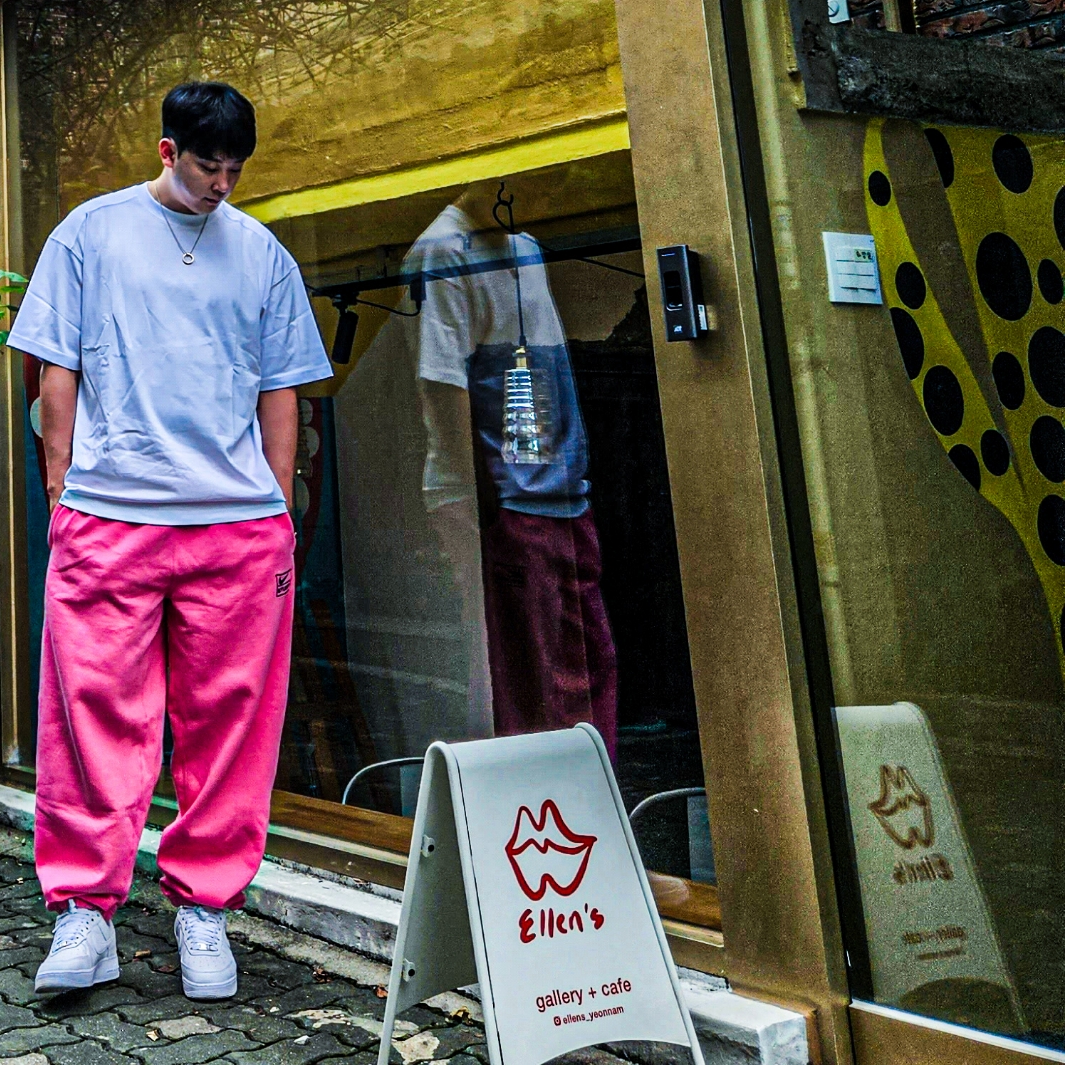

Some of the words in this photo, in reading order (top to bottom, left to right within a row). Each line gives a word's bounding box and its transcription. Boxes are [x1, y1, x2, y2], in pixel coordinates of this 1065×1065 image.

[519, 903, 605, 944] Ellen's
[536, 989, 583, 1013] gallery
[601, 977, 632, 996] cafe
[562, 1005, 625, 1025] ellens_yeonnam
